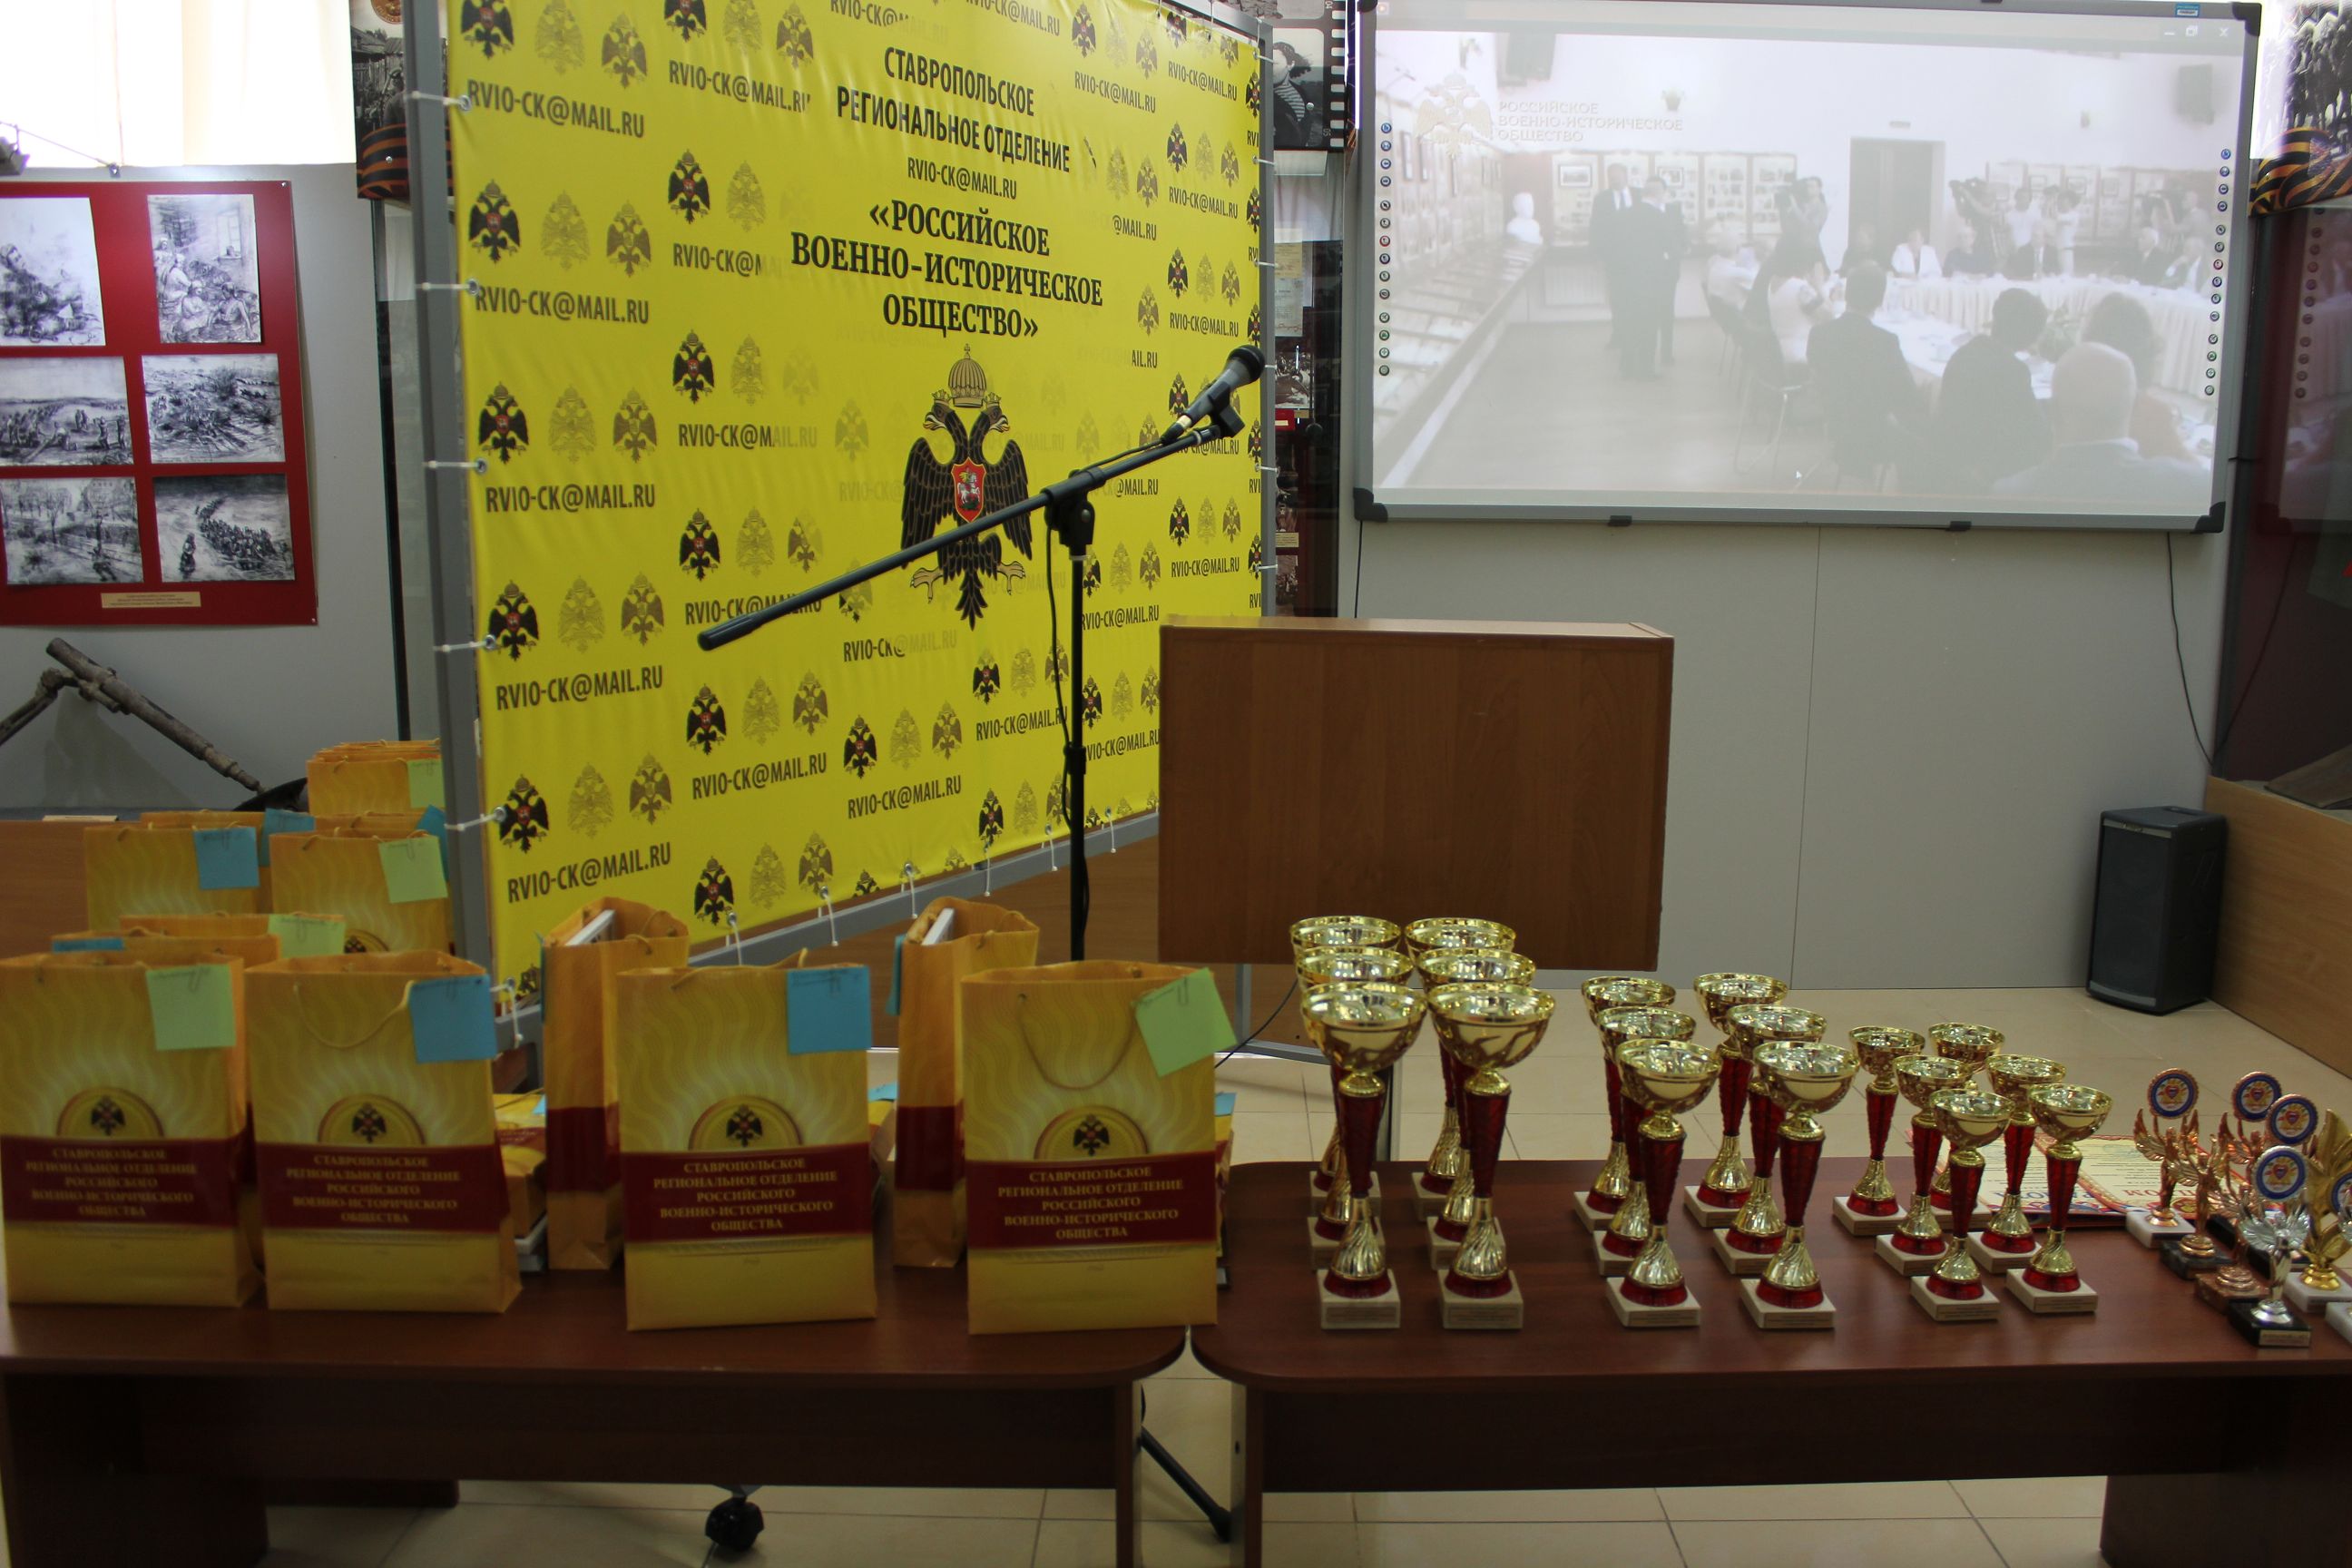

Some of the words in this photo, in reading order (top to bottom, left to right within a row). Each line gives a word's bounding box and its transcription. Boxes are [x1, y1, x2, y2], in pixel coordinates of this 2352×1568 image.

[884, 46, 1034, 116] СТАВРОПОЛЬСКОЕ
[1074, 71, 1156, 113] RVIO-CK@MAIL.RU
[1168, 60, 1238, 102] RVIO-CK@MAIL.RU
[466, 79, 645, 139] RVIO-CK@MAIL.RU
[837, 85, 980, 151] РЕГИОНАЛЬНОЕ
[984, 125, 1071, 173] ОТДЕЛЕНИЕ
[907, 157, 1017, 200] RVIO-CK@MAIL.RU
[1169, 186, 1238, 220] RVIO-CK@MAIL.RU
[869, 199, 1050, 257] «РОССИЙСКОЕ
[790, 231, 1103, 307] ВОЕННО-ИСТОРИЧЕСКОЕ
[475, 286, 650, 324] RVIO-CK@MAIL.RU
[882, 293, 1039, 338] ОБЩЕСТВО»
[1170, 312, 1239, 338] RVIO-CK@MAIL.RU
[485, 484, 656, 513] RVIO-CK@MAIL.RU
[1171, 556, 1240, 577] RVIO-CK@MAIL.RU
[496, 665, 663, 711] RVIO-CK@MAIL.RU
[692, 752, 828, 799] RVIO-CK@MAIL.RU
[848, 774, 962, 819] RVIO-CK@MAIL.RU
[507, 841, 671, 903] RVIO-CK@MAIL.RU
[653, 1175, 757, 1190] РЕГИОНАЛЬНОЕ
[760, 1171, 838, 1185] ОТДЕЛЕНИЕ
[684, 1158, 806, 1174] СТАВРОПОЛЬСКОЕ
[1029, 1166, 1152, 1182] СТАВРОПОЛЬСКОЕ
[697, 1188, 796, 1203] РОССИЙСКОГО
[998, 1183, 1103, 1198] РЕГИОНАЛЬНОЕ
[1106, 1180, 1183, 1195] ОТДЕЛЕНИЕ
[1042, 1196, 1141, 1211] РОССИЙСКОГО
[661, 1200, 834, 1220] ВОЕННО-ИСТОРИЧЕСКОГО
[711, 1219, 783, 1233] ОБЩЕСТВА
[1004, 1209, 1179, 1227] ВОЕННО-ИСТОРИЧЕСКОГО
[1056, 1226, 1128, 1241] ОБЩЕСТВА
